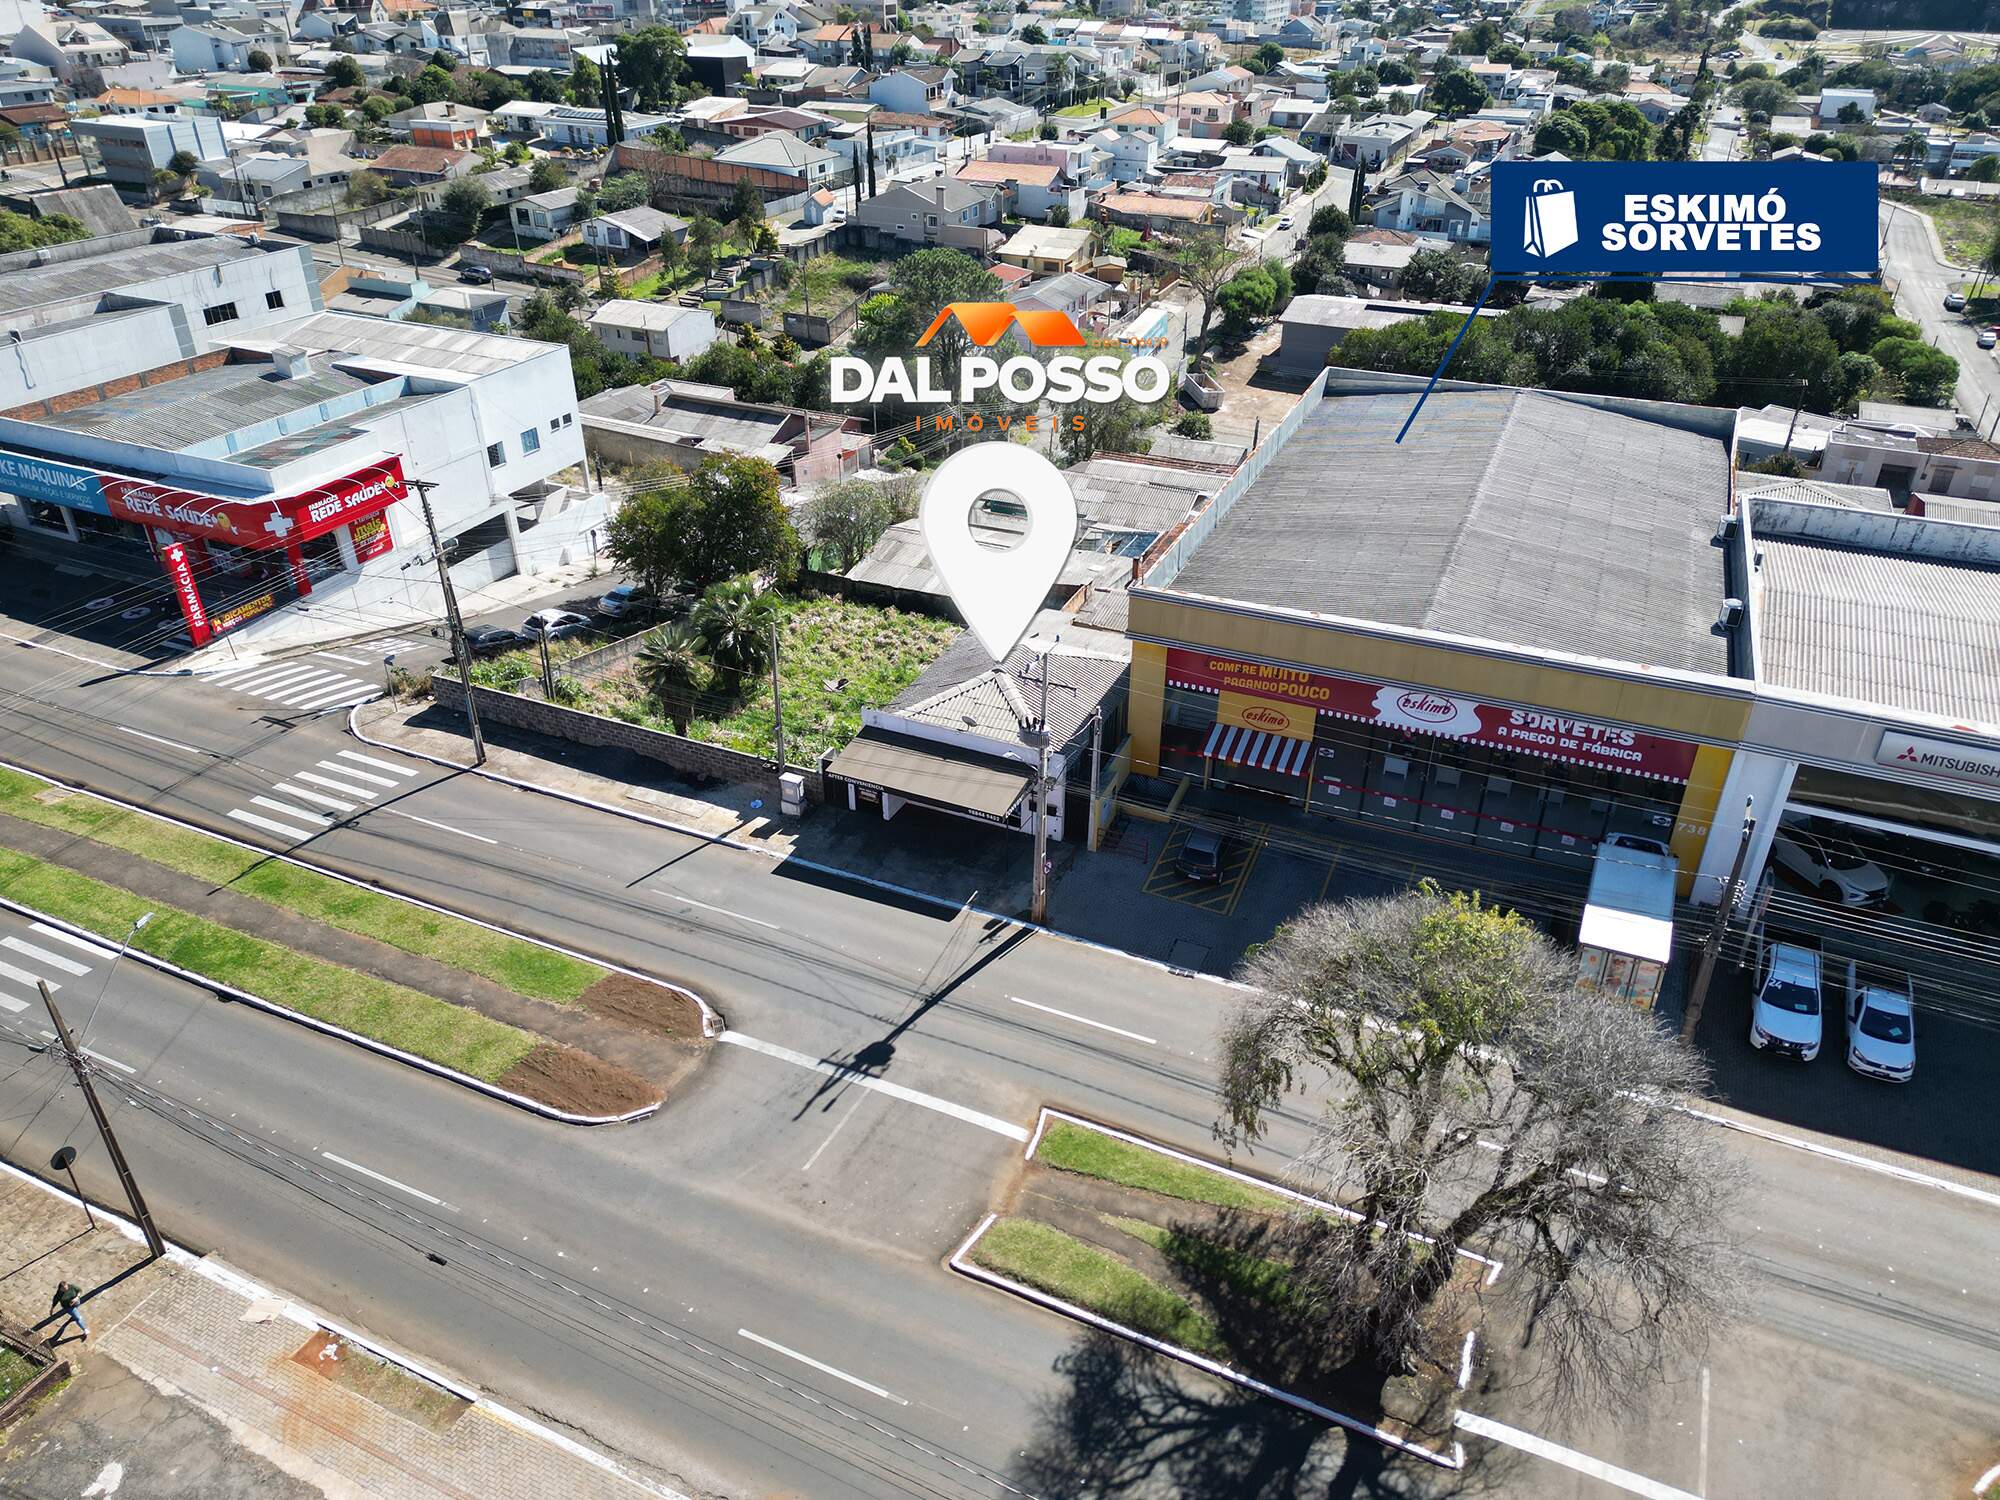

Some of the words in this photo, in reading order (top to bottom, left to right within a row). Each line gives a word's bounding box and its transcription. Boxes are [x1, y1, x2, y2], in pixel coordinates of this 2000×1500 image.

[17, 461, 88, 492] MÁQUINAS
[125, 496, 164, 517] REDE
[164, 504, 214, 528] SAÚDE
[310, 500, 343, 523] REDE
[177, 562, 205, 628] FARMÁCIA
[1223, 676, 1278, 692] PAGANDO
[1279, 681, 1330, 700] POUCO
[1260, 664, 1310, 683] MUITO
[1510, 709, 1636, 747] SORVETES
[1497, 726, 1507, 736] A
[1512, 728, 1556, 745] PREÇO
[1559, 737, 1578, 750] DE
[1582, 741, 1643, 762] FÁBRICA
